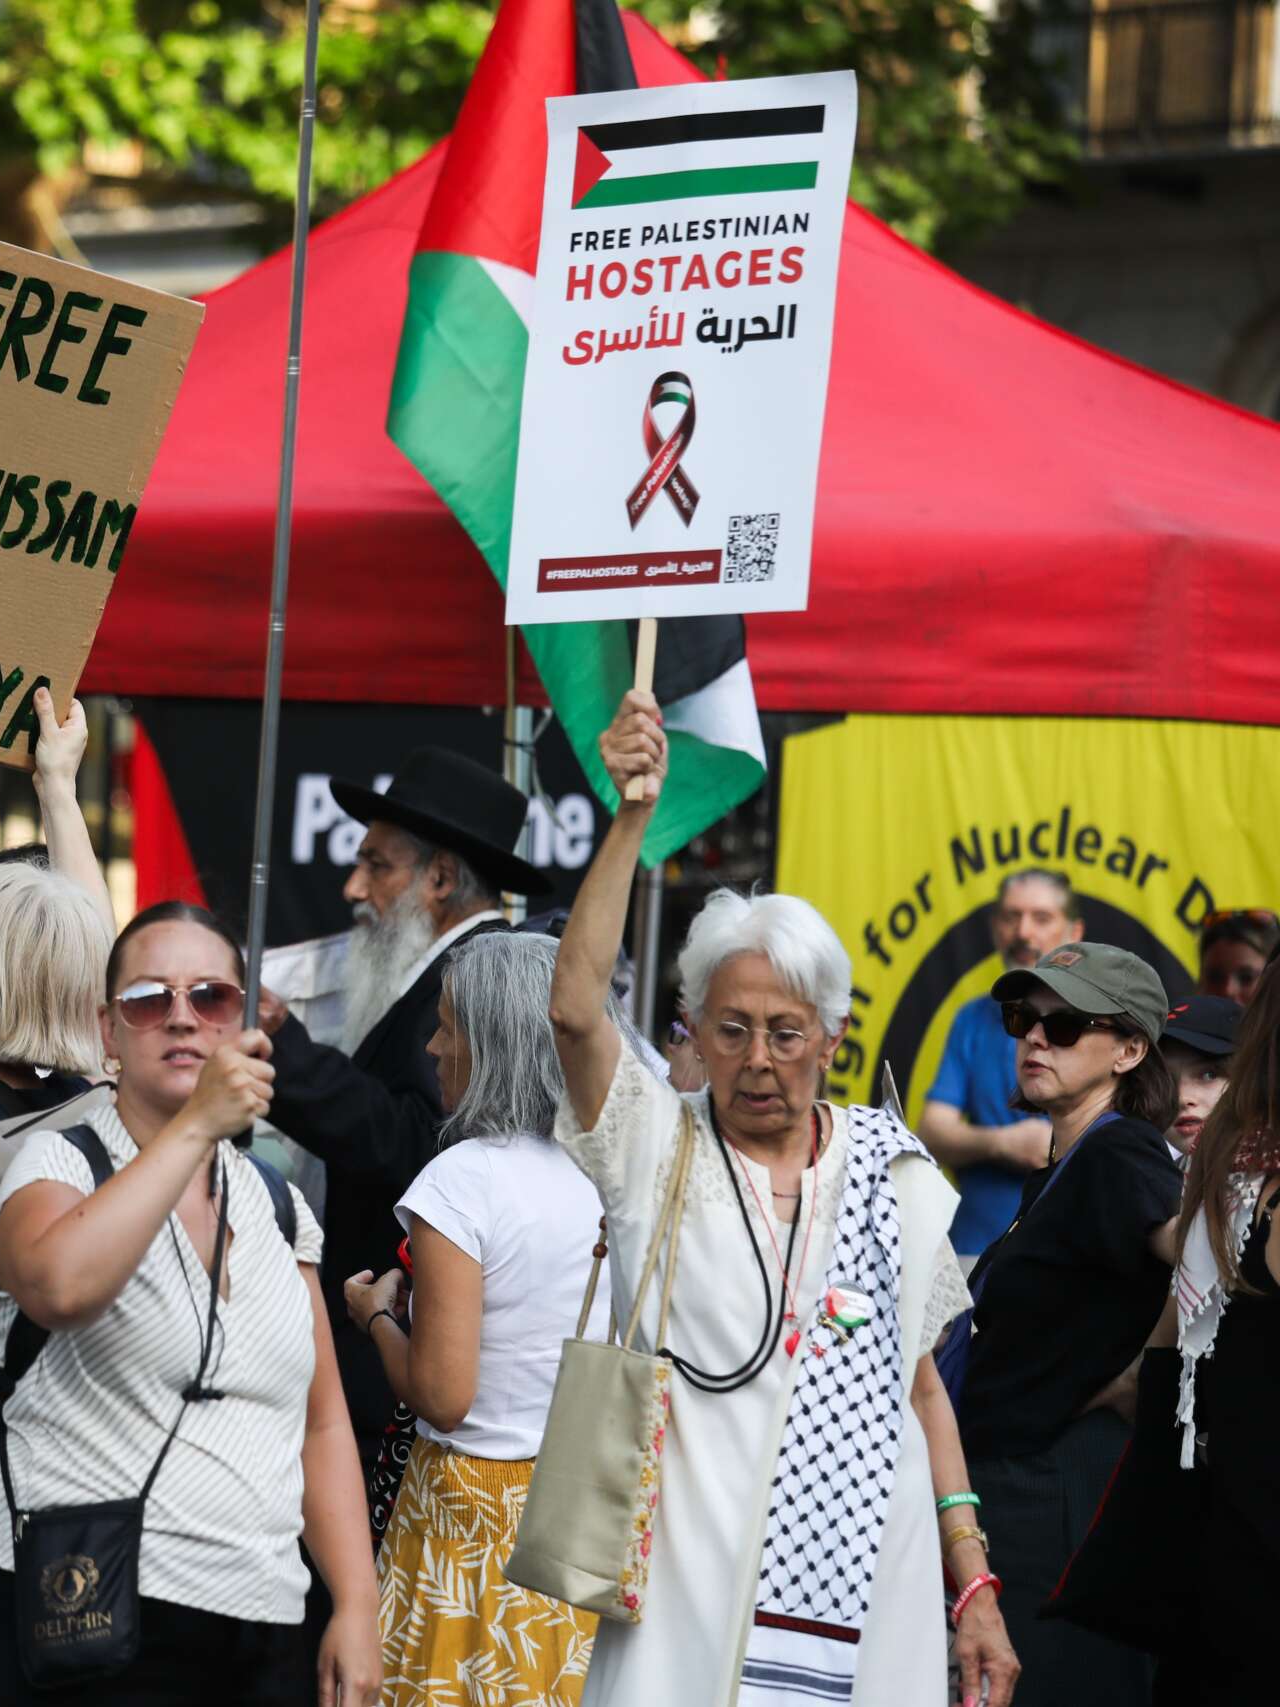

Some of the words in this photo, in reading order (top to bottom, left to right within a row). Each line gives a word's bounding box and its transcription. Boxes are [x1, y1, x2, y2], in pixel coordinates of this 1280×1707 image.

[569, 228, 632, 252] FREE
[640, 212, 810, 246] PALESTINIAN
[565, 246, 806, 301] HOSTAGES
[562, 305, 685, 365] للأسرى
[696, 304, 797, 354] الحرية
[862, 871, 936, 967] for
[950, 804, 1168, 891] Nuclear
